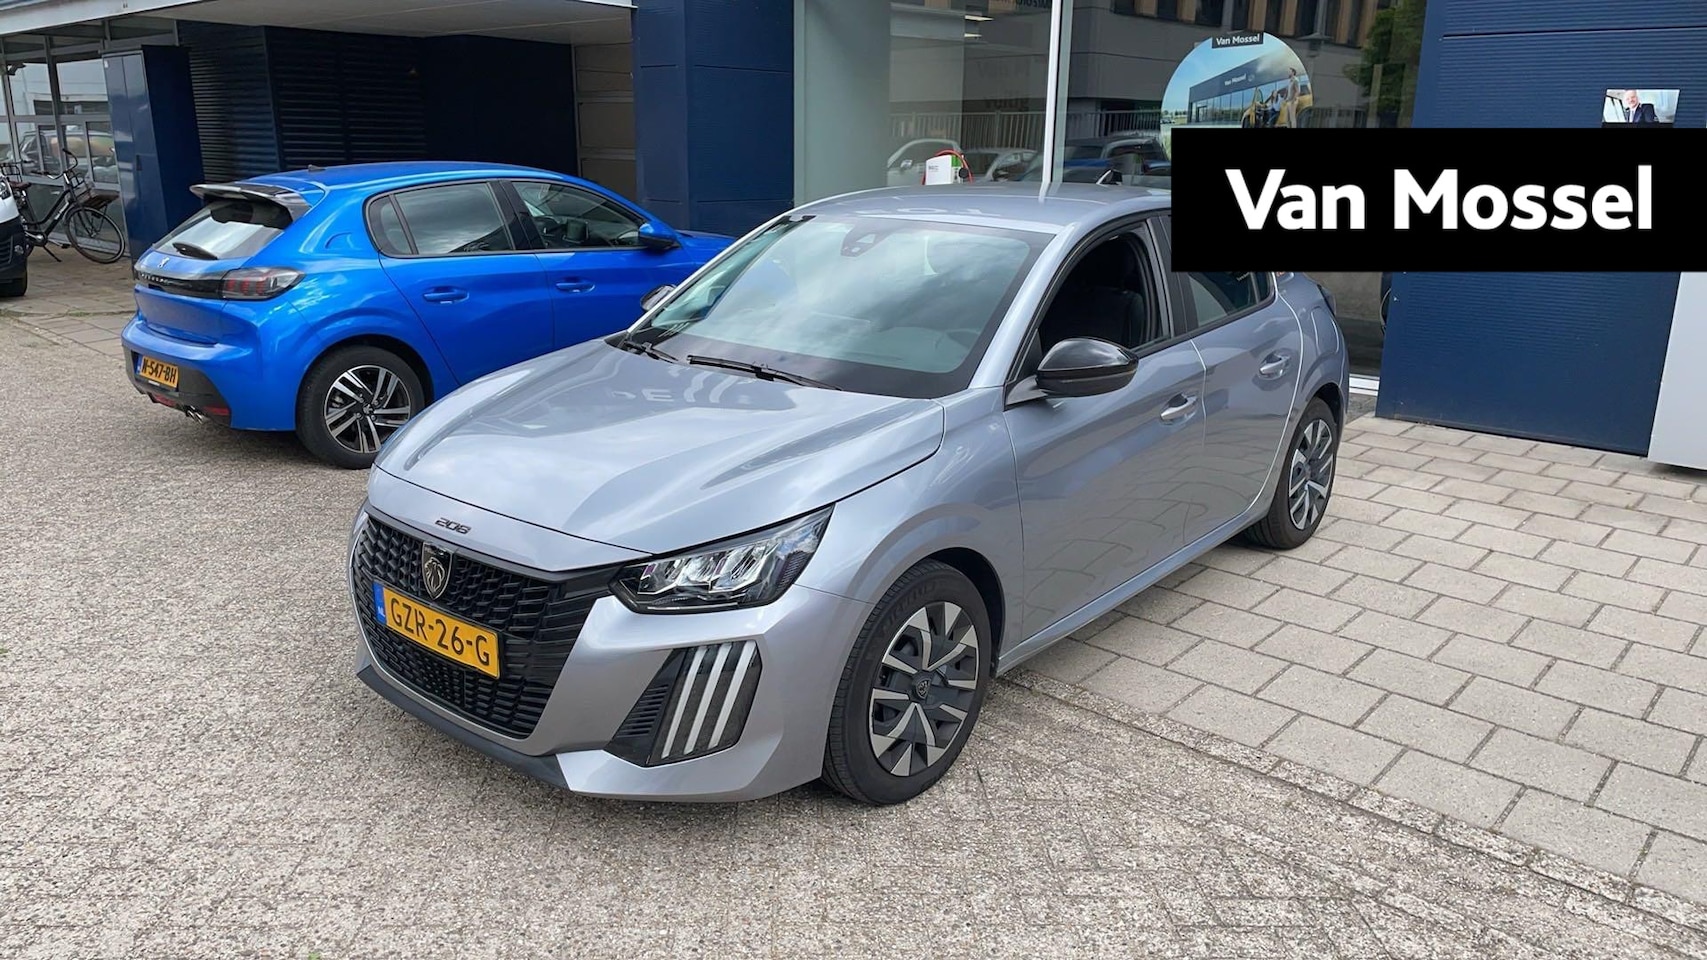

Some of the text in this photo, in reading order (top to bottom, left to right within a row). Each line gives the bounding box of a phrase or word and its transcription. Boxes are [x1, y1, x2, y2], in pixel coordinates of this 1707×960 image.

[1232, 33, 1260, 43] Mossel
[141, 359, 177, 384] N-547-BH
[390, 597, 490, 666] GZR-26-G
